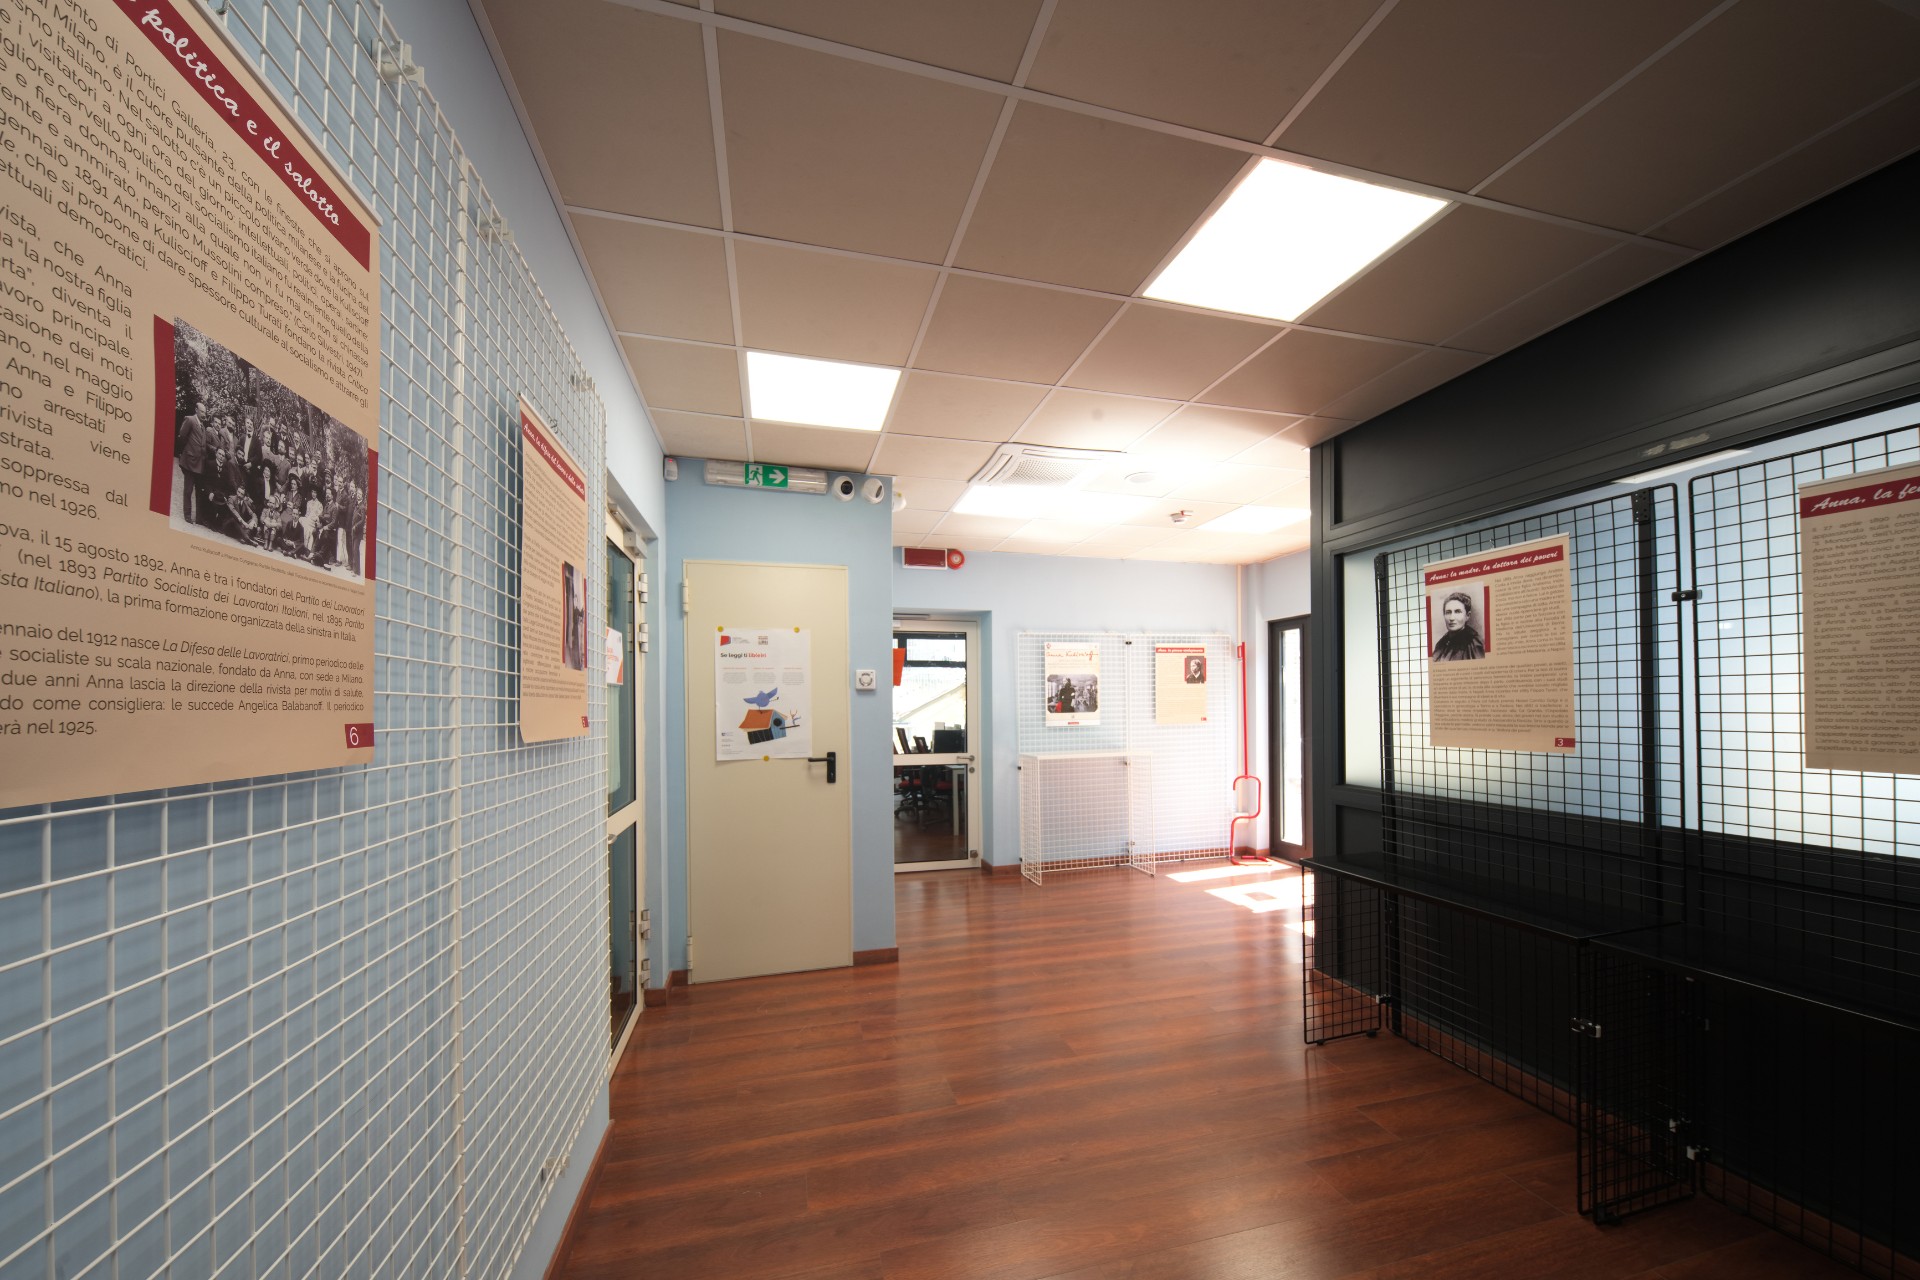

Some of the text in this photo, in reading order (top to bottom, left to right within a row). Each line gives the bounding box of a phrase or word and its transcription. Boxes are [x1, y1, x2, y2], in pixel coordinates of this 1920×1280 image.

[125, 51, 165, 101] Portici
[141, 8, 340, 227] politica e il salotto
[74, 165, 281, 329] 1891 Anna Kuliscioff e Filippo Turati
[142, 196, 189, 239] persino
[192, 233, 242, 282] Mussolini
[43, 256, 94, 296] nostra
[97, 287, 131, 318] figlia
[53, 240, 132, 298] che Anna
[51, 285, 133, 340] diventa il
[42, 350, 133, 401] nel maggio
[69, 340, 132, 381] dei moti
[5, 356, 132, 422] Anna e Filippo
[43, 399, 131, 443] arrestati e
[89, 440, 130, 464] viene
[1, 456, 127, 507] soppressa dal
[28, 490, 56, 508] nel
[1873, 488, 1894, 500] la
[17, 548, 279, 613] (nel 1893 Partito Socialista dei Lavoratori
[40, 528, 50, 545] il
[54, 535, 72, 552] 15
[77, 541, 129, 563] agosto
[170, 561, 200, 579] Anna
[203, 569, 210, 581] è
[213, 571, 227, 585] tra
[230, 575, 233, 586] i
[236, 576, 277, 596] fondatori
[279, 588, 294, 600] del
[1492, 560, 1518, 569] dottora
[1533, 551, 1558, 562] poveri
[107, 588, 119, 603] la
[123, 593, 161, 610] prima
[164, 598, 228, 621] formazione
[230, 613, 283, 630] organizzata
[9, 647, 89, 665] socialiste
[94, 655, 111, 667] su
[117, 656, 151, 669] scala
[218, 662, 256, 676] fondato
[259, 666, 271, 677] da
[56, 626, 83, 642] del
[86, 632, 117, 646] 1912
[120, 636, 160, 650] nasce
[162, 638, 178, 651] La
[180, 640, 215, 656] Difesa
[216, 645, 241, 658] delle
[1, 669, 291, 694] due anni Anna lascia la direzione della rivista
[26, 718, 54, 734] nel
[32, 698, 81, 710] come
[171, 697, 182, 710] le
[187, 698, 234, 710] succede
[237, 699, 278, 713] Angelica
[348, 726, 359, 746] 6
[1558, 738, 1564, 746] 3
